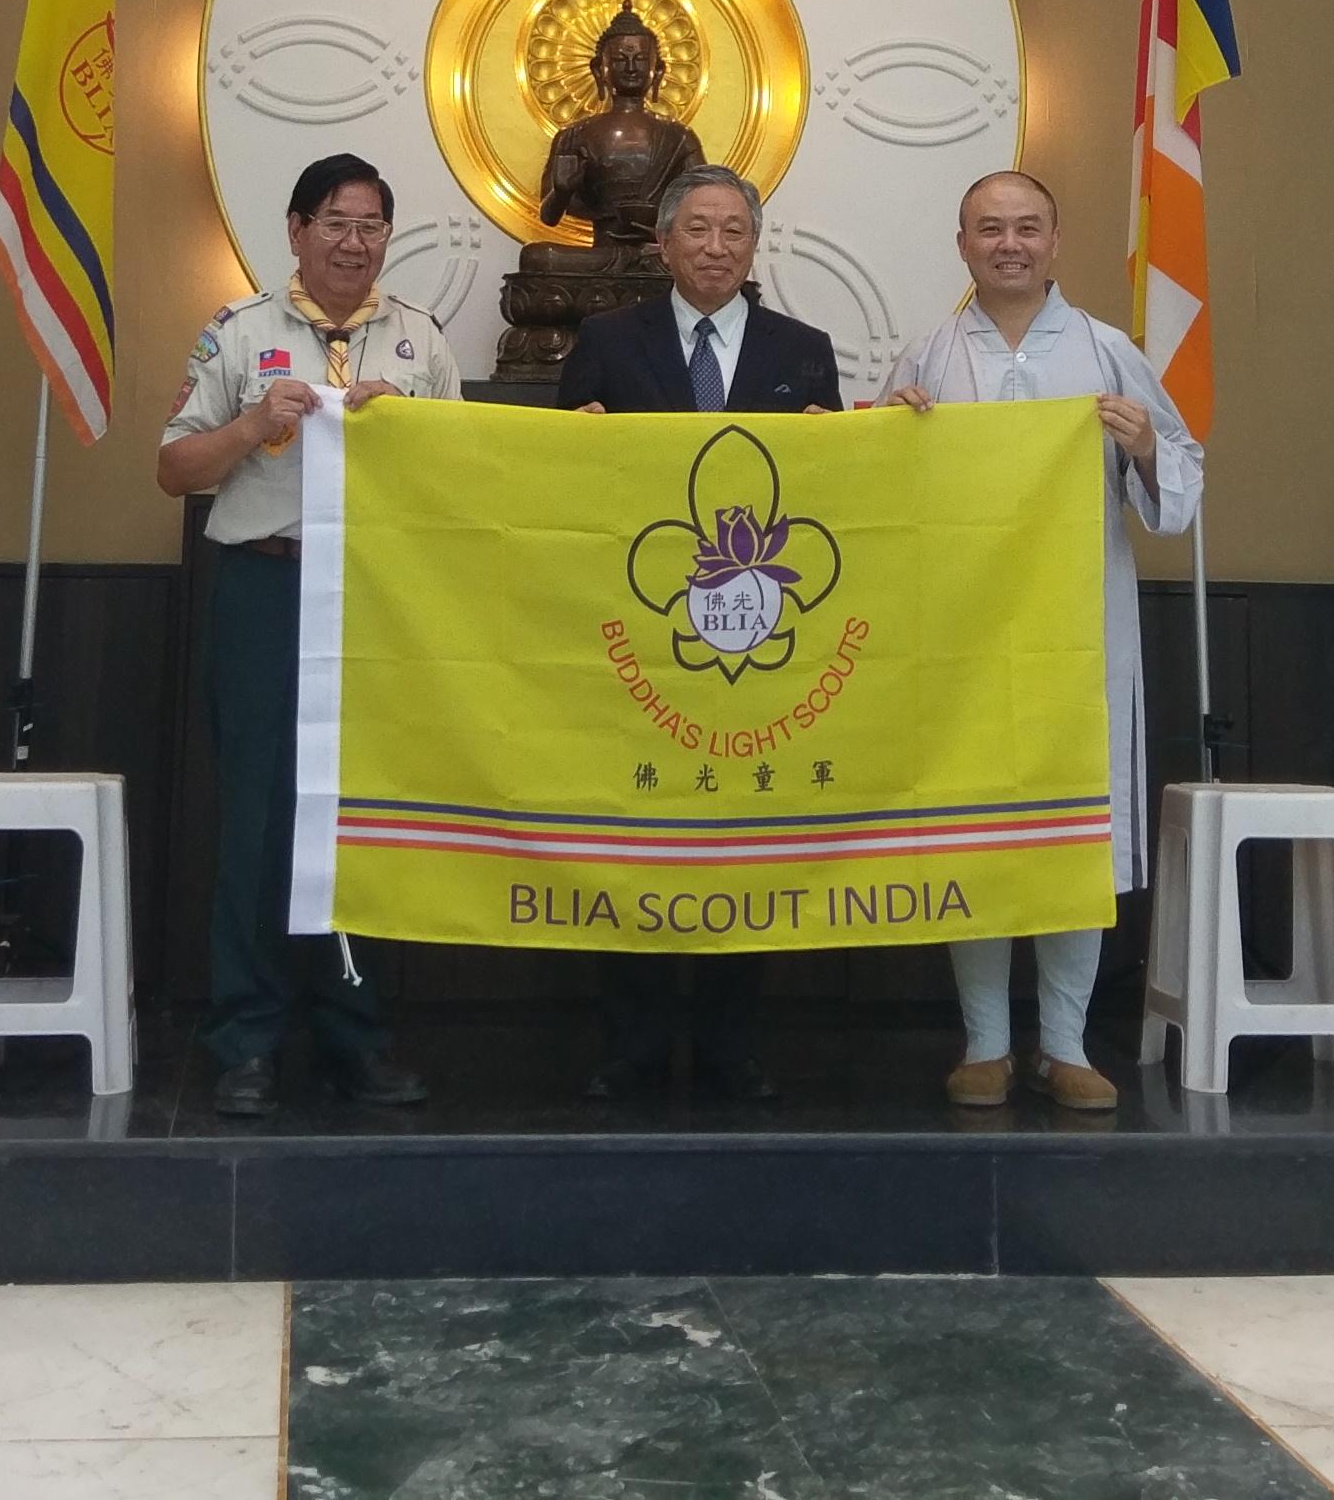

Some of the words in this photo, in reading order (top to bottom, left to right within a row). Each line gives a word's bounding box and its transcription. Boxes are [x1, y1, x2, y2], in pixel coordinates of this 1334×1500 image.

[704, 591, 754, 612] 佛光
[702, 613, 769, 631] BLIA
[601, 619, 703, 750] BUDDHA'S
[708, 715, 793, 758] LIGHT
[792, 616, 871, 729] SCOUTS
[633, 759, 835, 793] 佛光童軍
[510, 883, 621, 929] BLIA
[637, 887, 810, 934] SCOUT
[828, 879, 972, 926] INDIA
